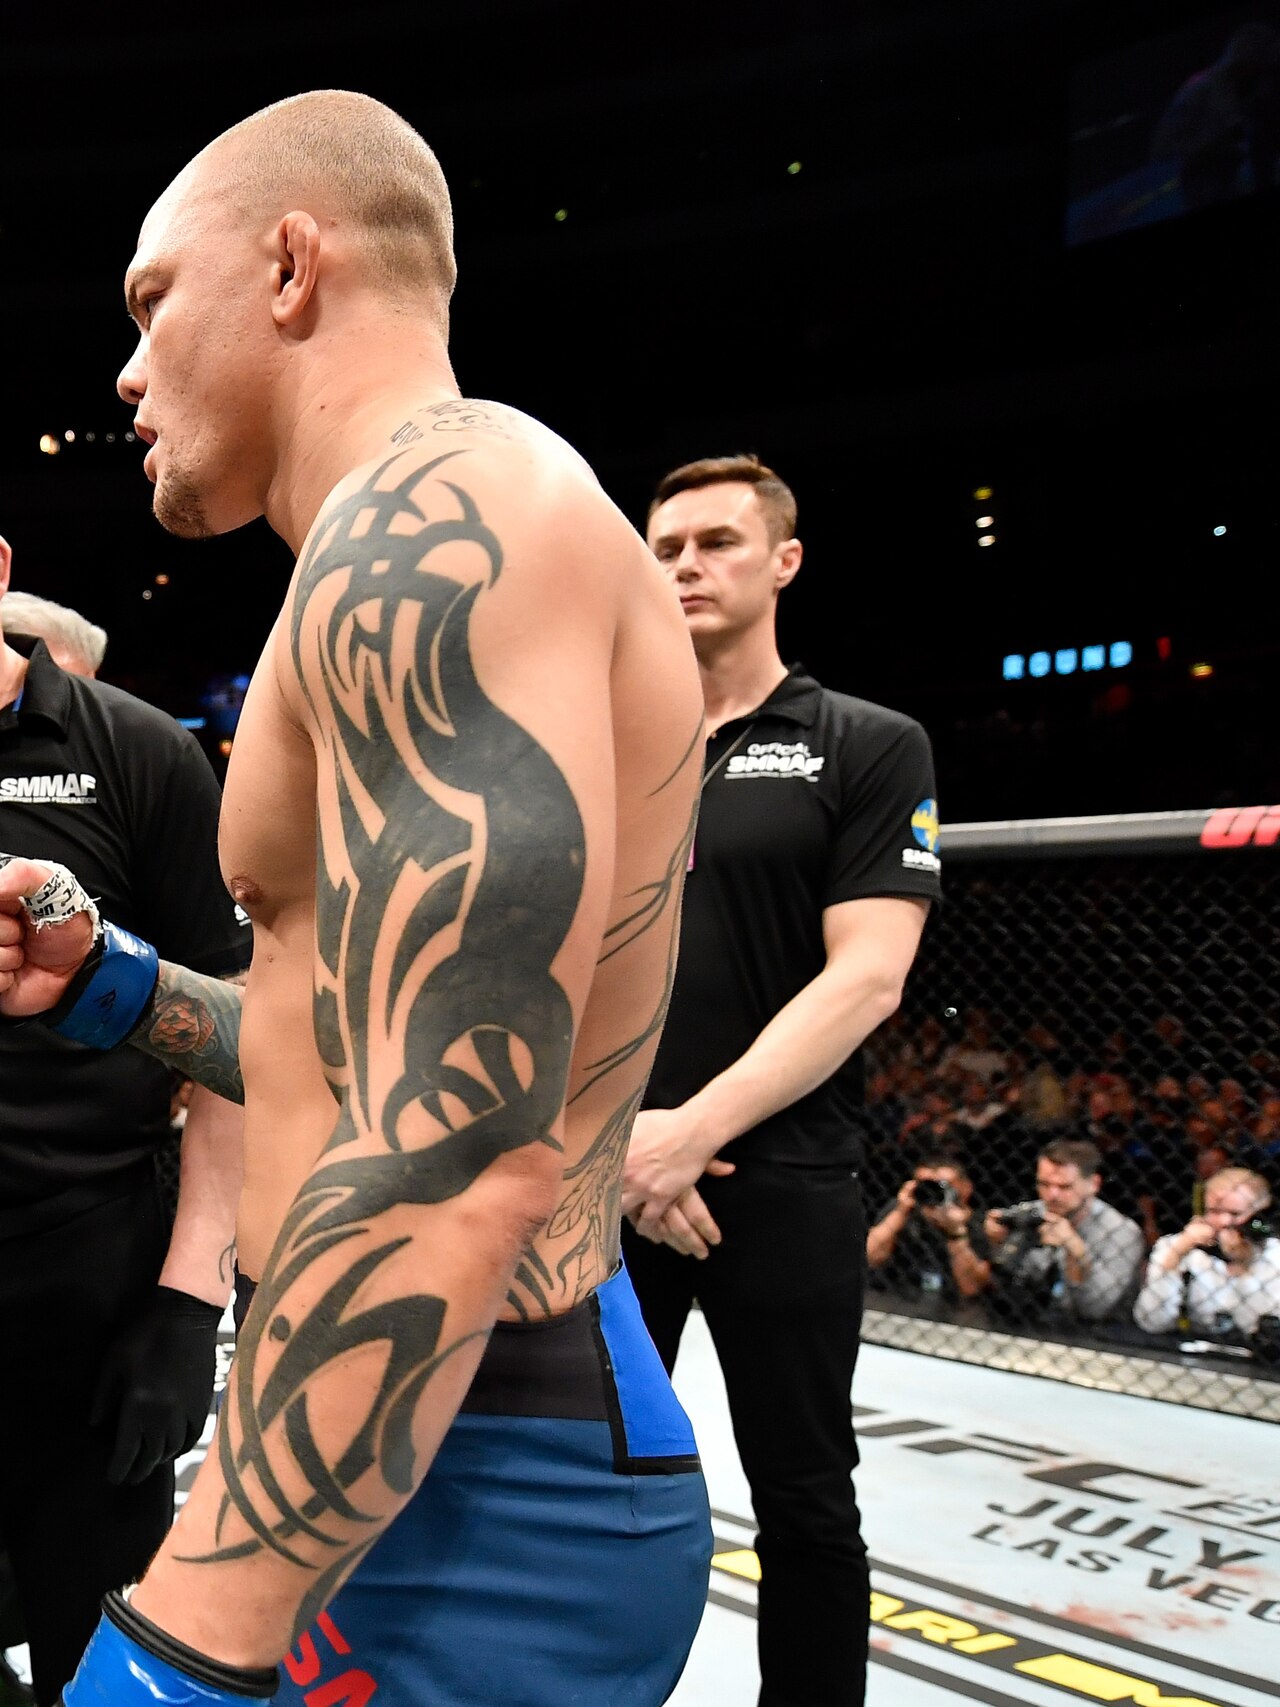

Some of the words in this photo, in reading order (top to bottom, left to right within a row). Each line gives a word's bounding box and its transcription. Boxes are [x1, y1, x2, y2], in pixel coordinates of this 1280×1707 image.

[1003, 641, 1132, 680] ROUND
[0, 773, 96, 797] SMMAF
[972, 1523, 1122, 1575] LAS
[987, 1500, 1265, 1571] JULY
